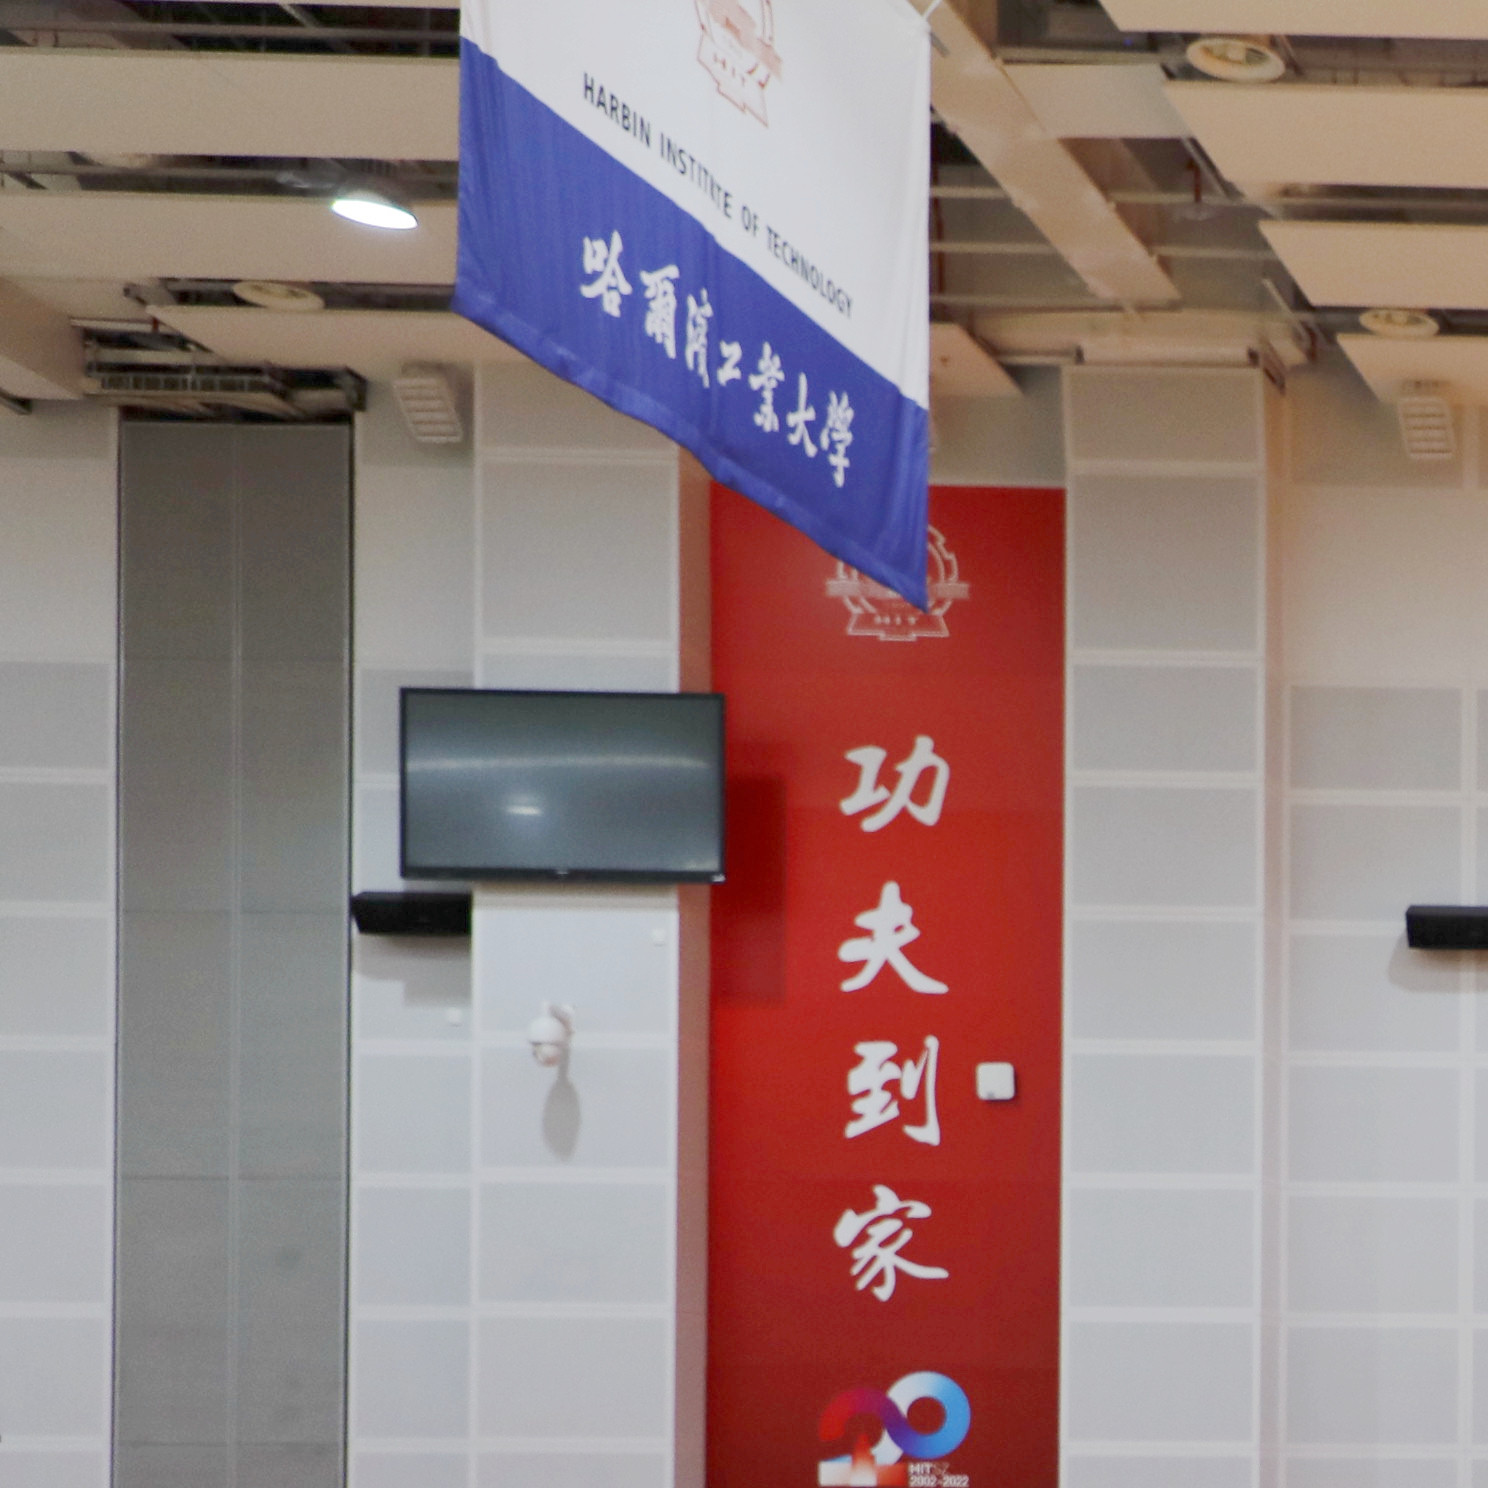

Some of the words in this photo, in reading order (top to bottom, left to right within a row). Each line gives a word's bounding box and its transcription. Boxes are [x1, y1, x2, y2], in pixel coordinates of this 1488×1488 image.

[583, 72, 650, 148] HARBIN
[741, 204, 758, 238] OF
[766, 224, 852, 318] TECHNOLOGY
[834, 736, 949, 1301] 功夫到家
[909, 1474, 970, 1488] 2002-2022
